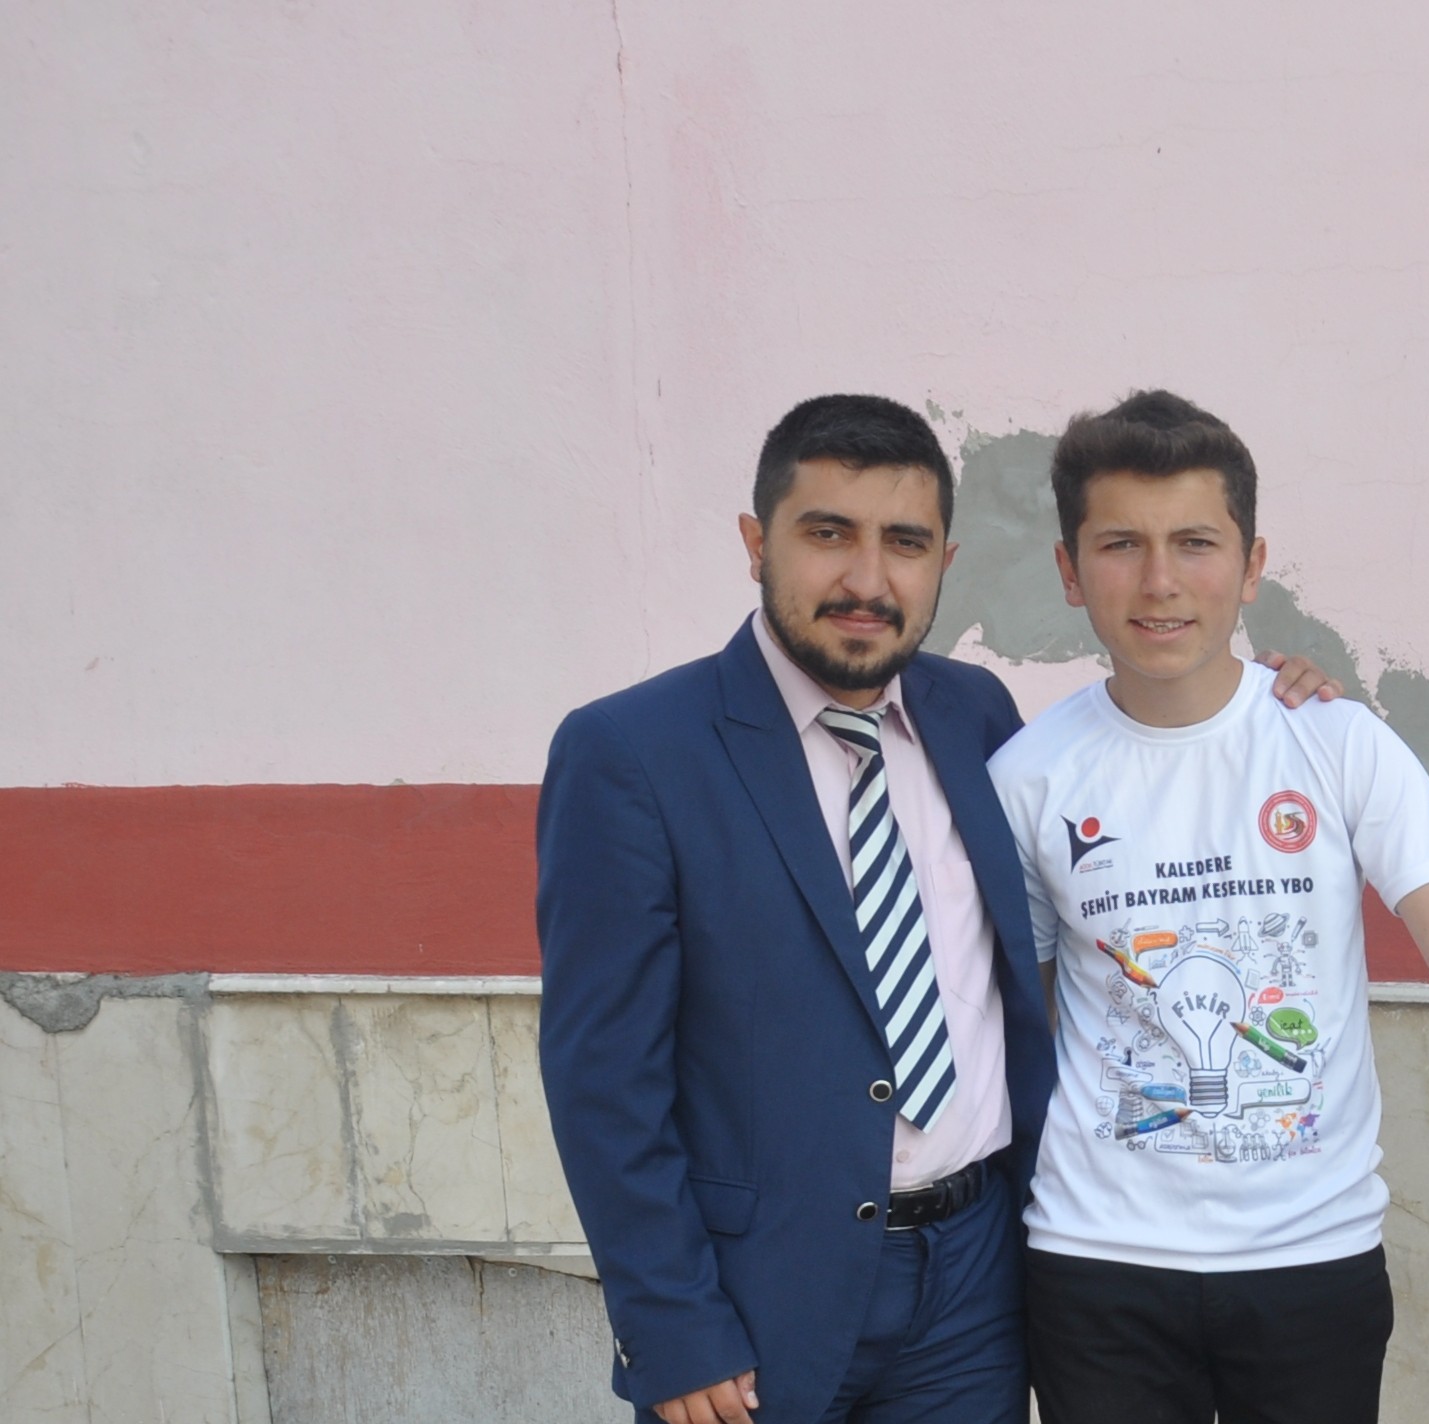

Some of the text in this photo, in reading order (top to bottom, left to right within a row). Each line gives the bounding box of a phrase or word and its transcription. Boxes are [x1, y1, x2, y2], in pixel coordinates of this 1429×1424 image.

[1155, 855, 1233, 879] KALEDERE
[1080, 876, 1314, 920] ŞEHİT BAYRAM KESEKLER YBO
[1171, 990, 1231, 1020] FİKİR
